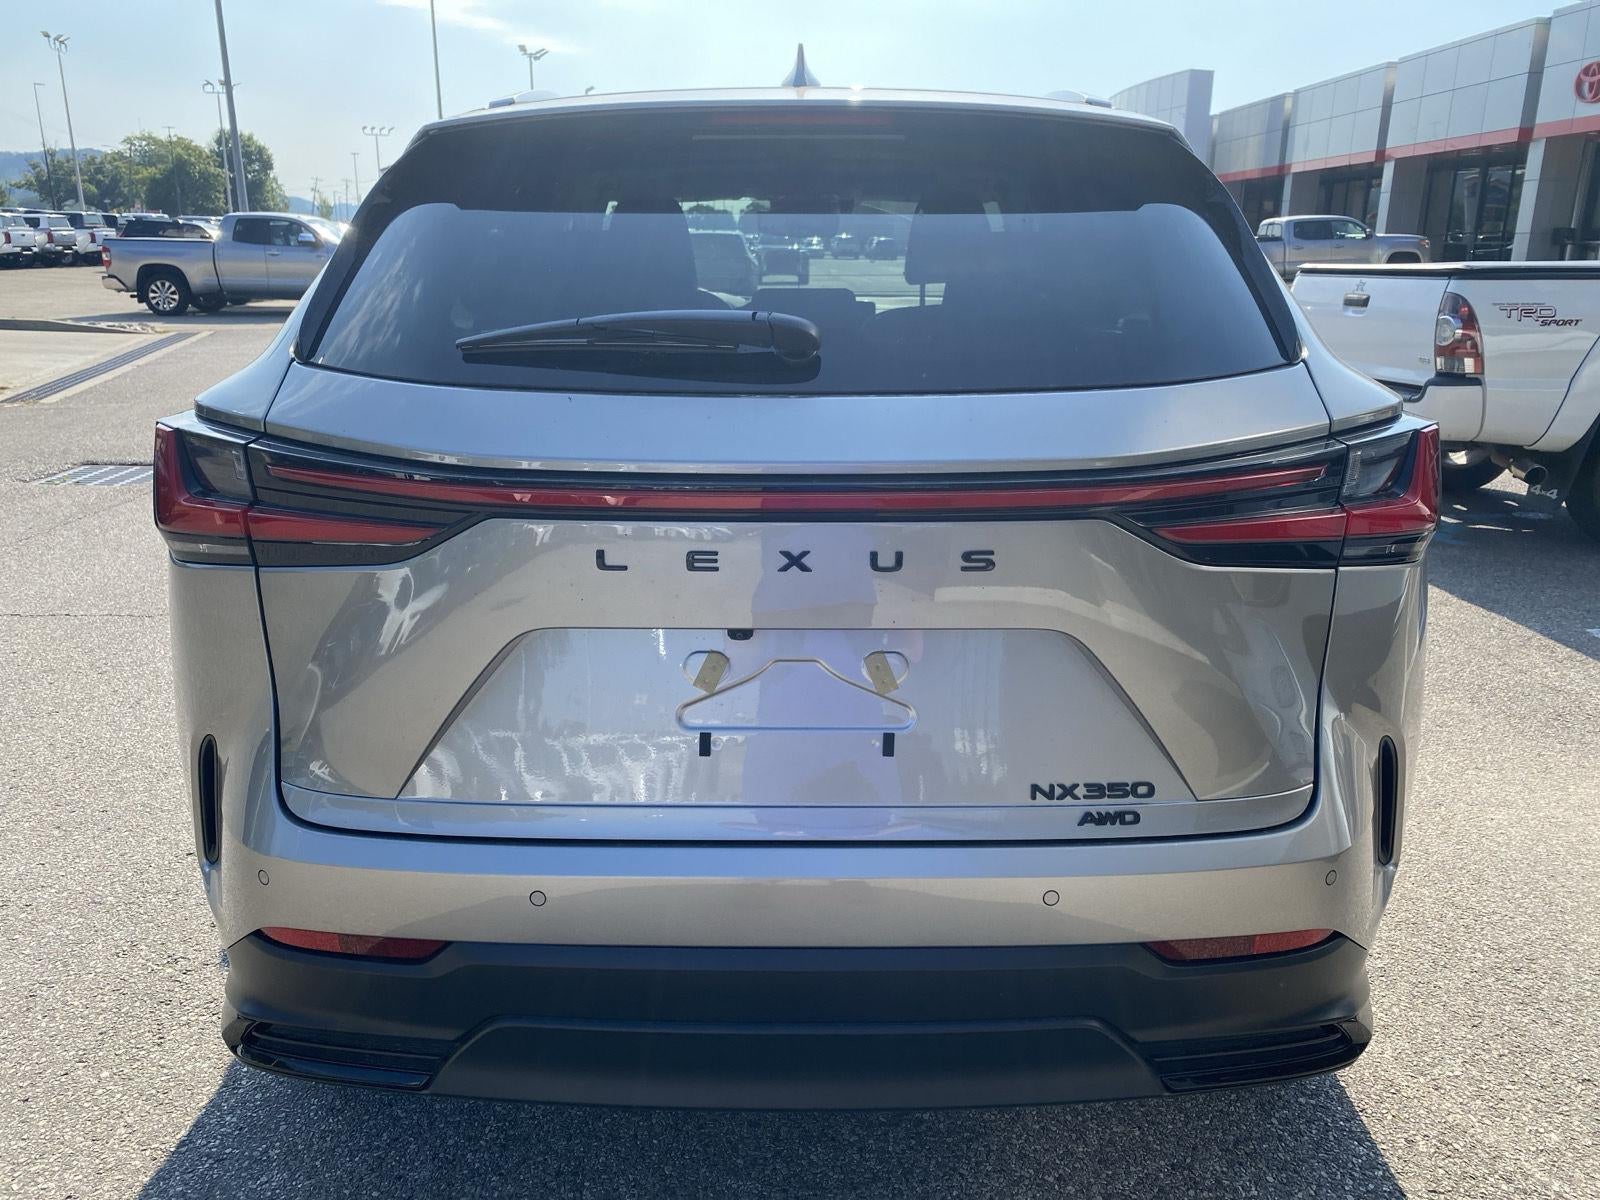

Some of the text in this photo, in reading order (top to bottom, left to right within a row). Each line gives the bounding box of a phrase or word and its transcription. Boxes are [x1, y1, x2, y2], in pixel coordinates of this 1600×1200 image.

[1499, 305, 1556, 322] TRD
[1540, 319, 1583, 327] SPORT
[595, 549, 996, 573] LEXUS
[1030, 781, 1156, 801] NX350
[1077, 810, 1141, 827] AWD
